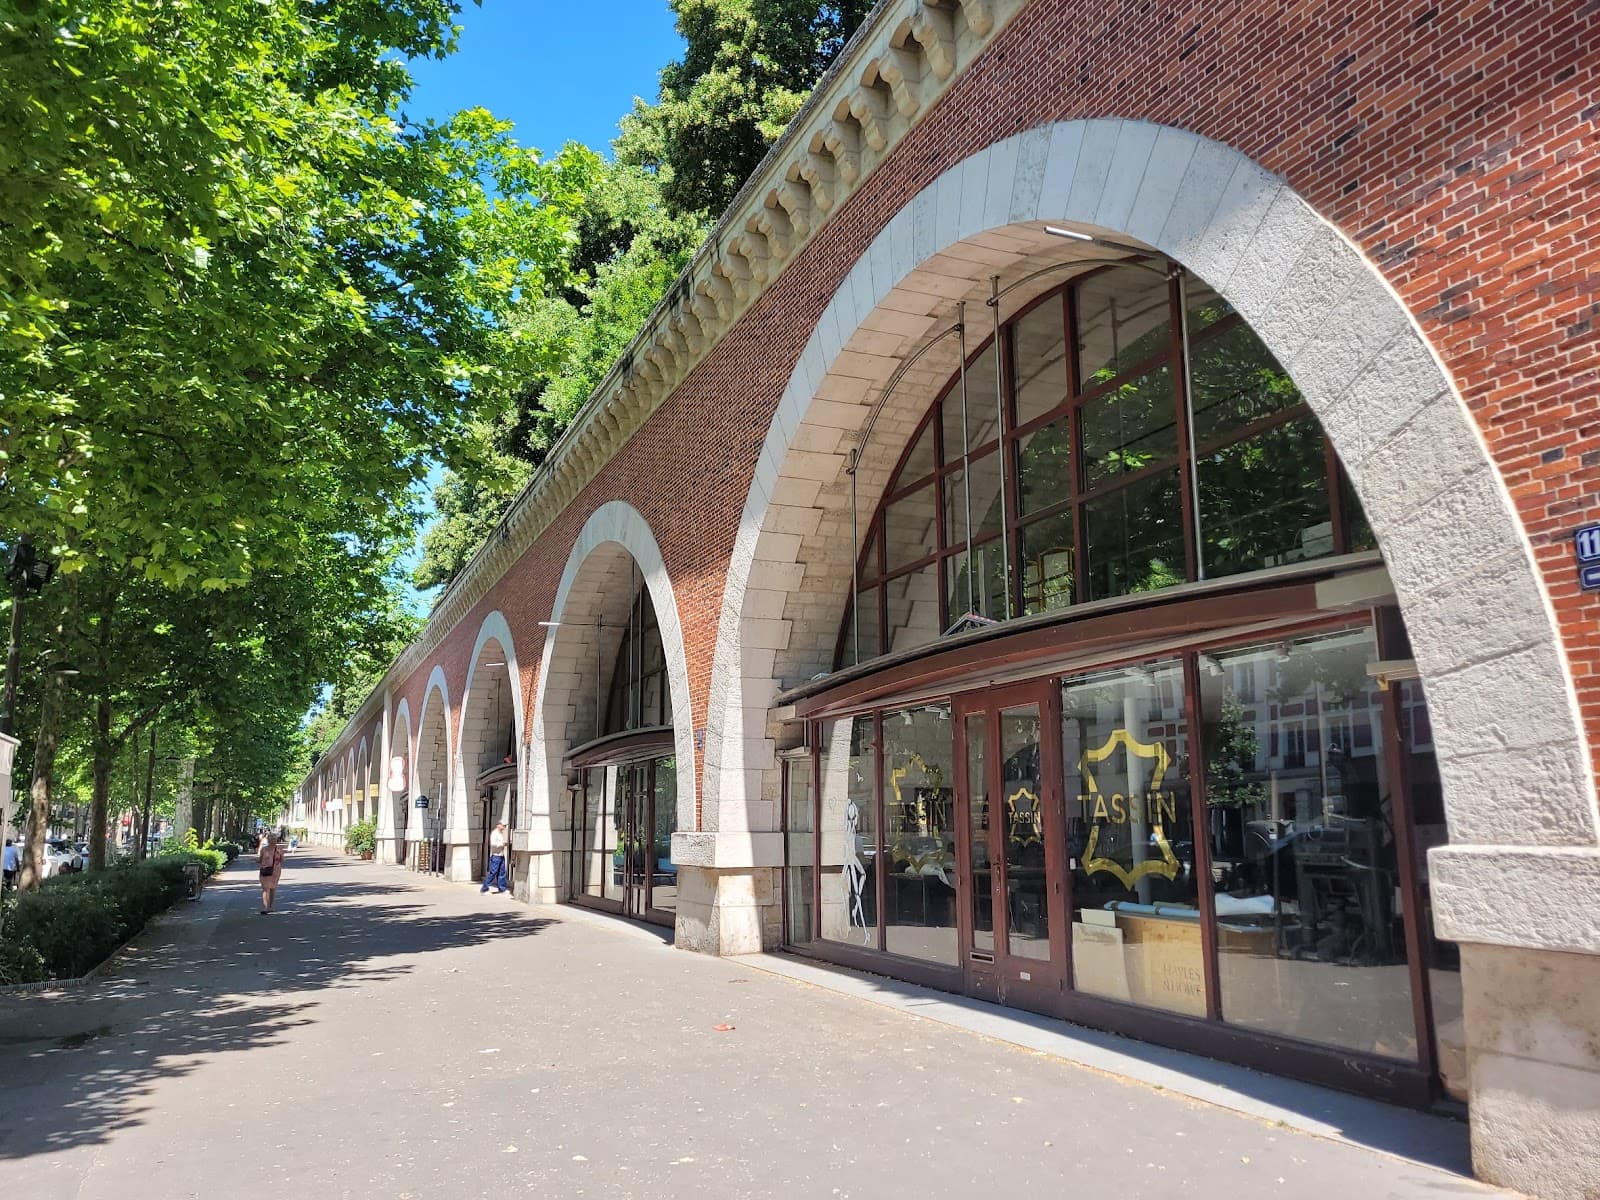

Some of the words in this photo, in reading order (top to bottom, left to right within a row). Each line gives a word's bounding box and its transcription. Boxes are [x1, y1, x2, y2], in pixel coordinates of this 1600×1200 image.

[888, 800, 947, 826] SSIN
[1008, 811, 1041, 824] TASSIN
[1077, 791, 1176, 824] TASSIN
